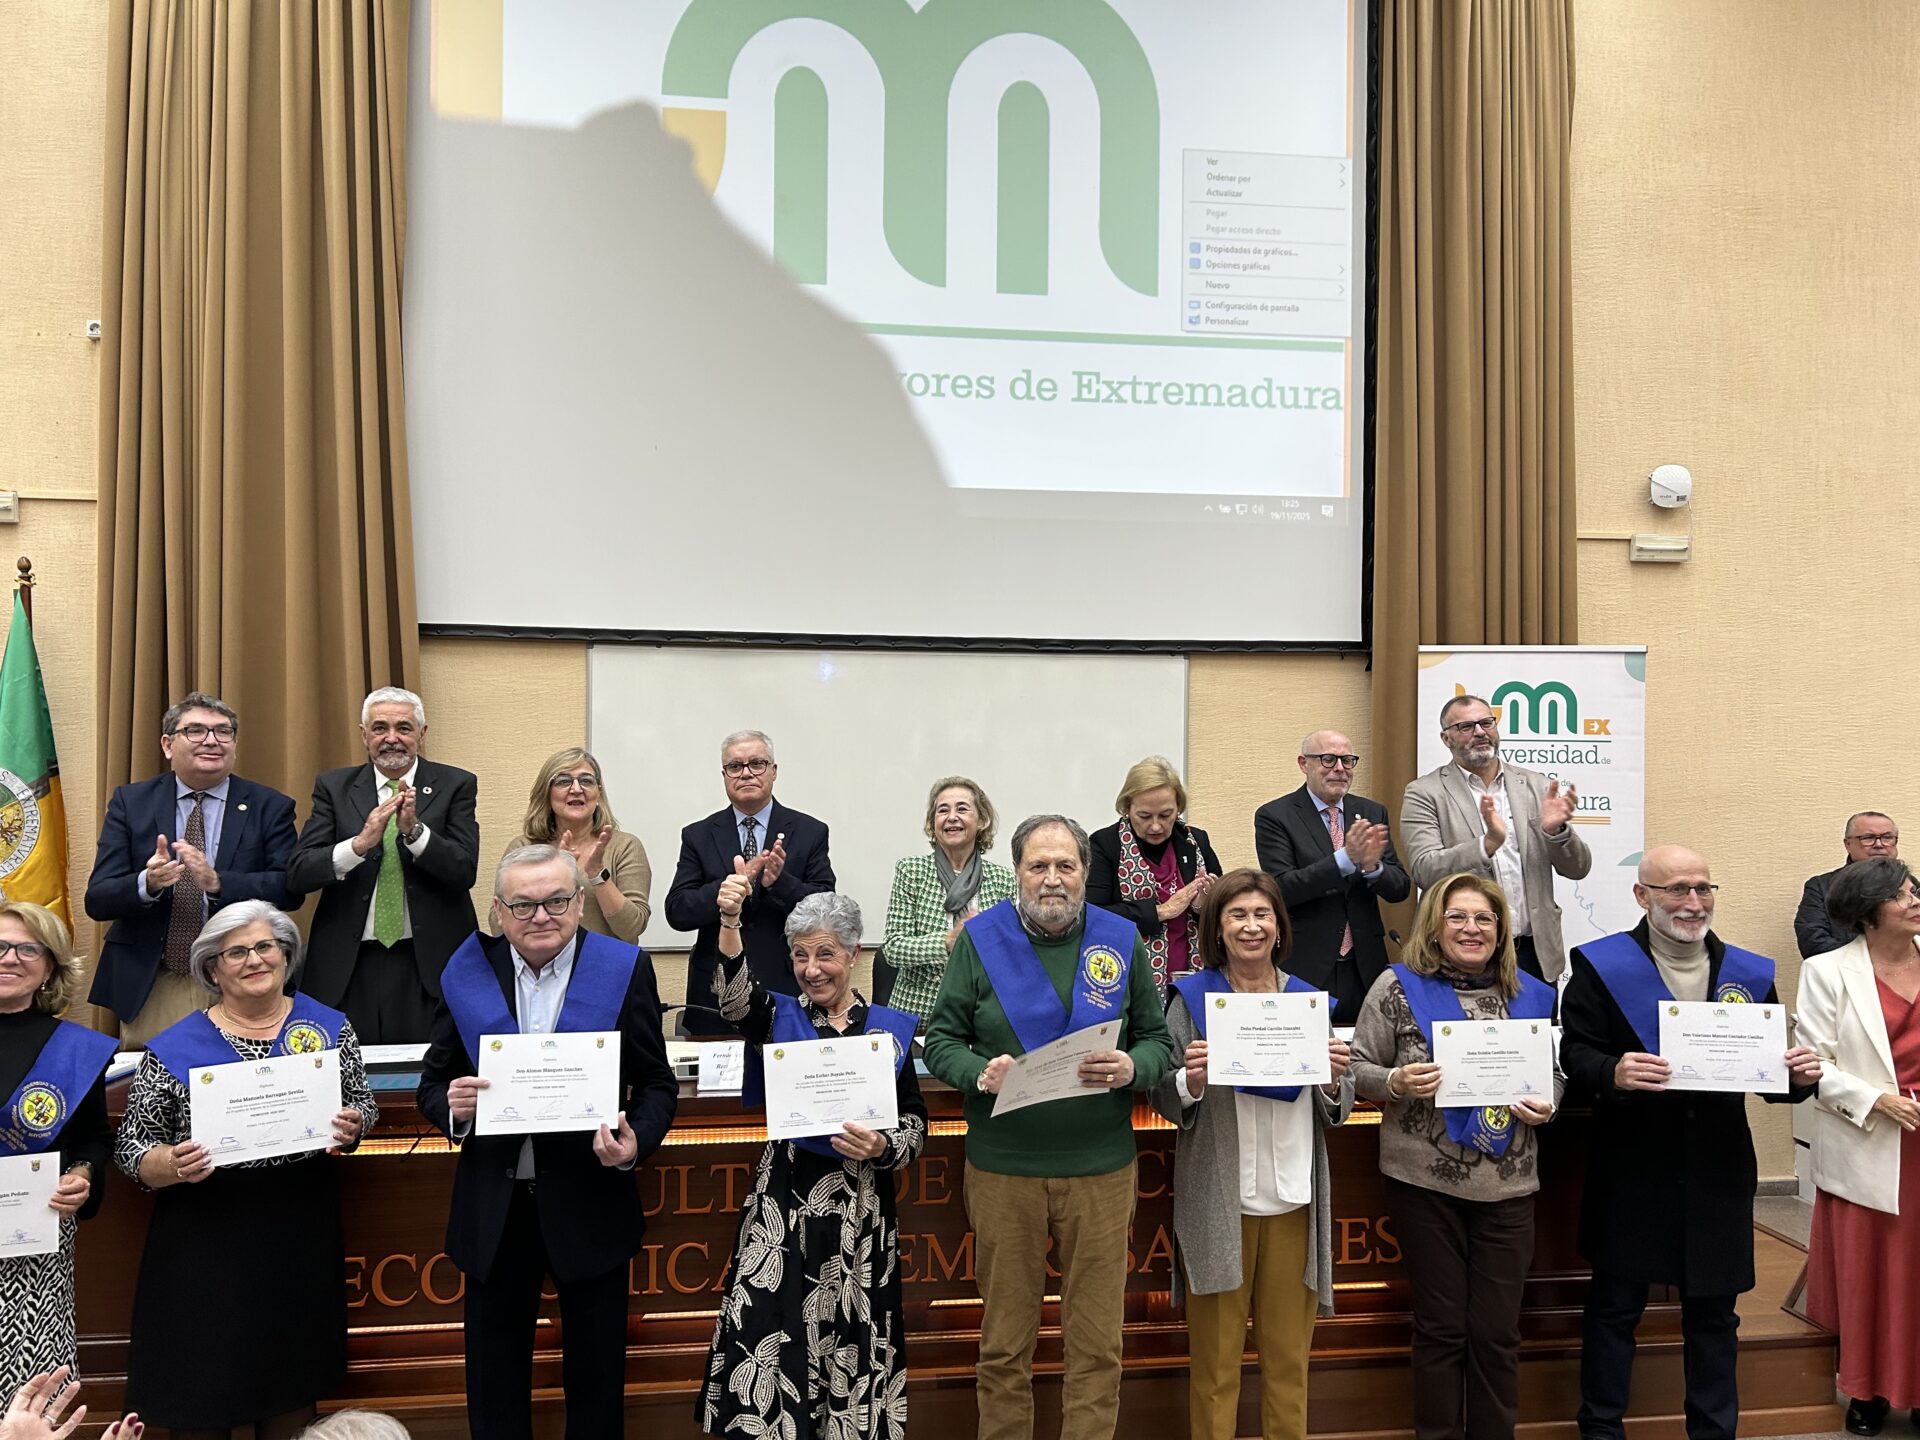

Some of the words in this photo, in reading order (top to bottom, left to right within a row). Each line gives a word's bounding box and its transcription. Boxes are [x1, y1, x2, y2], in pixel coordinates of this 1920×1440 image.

[1206, 157, 1219, 166] Ver
[1206, 173, 1236, 182] Ordenar
[1237, 176, 1251, 184] por
[1206, 189, 1243, 198] Actualizar
[1206, 209, 1228, 219] Pegar
[1206, 224, 1228, 235] Pegar
[1206, 245, 1251, 255] Propiedades
[1252, 247, 1262, 255] de
[1206, 260, 1240, 272] Opciones
[1206, 281, 1230, 290] Nuevo
[1205, 301, 1258, 313] Configuración
[1259, 303, 1269, 311] de
[1270, 304, 1300, 314] pantalla
[1205, 317, 1249, 326] Personalizar
[1009, 369, 1058, 401] de
[1071, 371, 1344, 410] Extremadura
[1601, 757, 1611, 765] de
